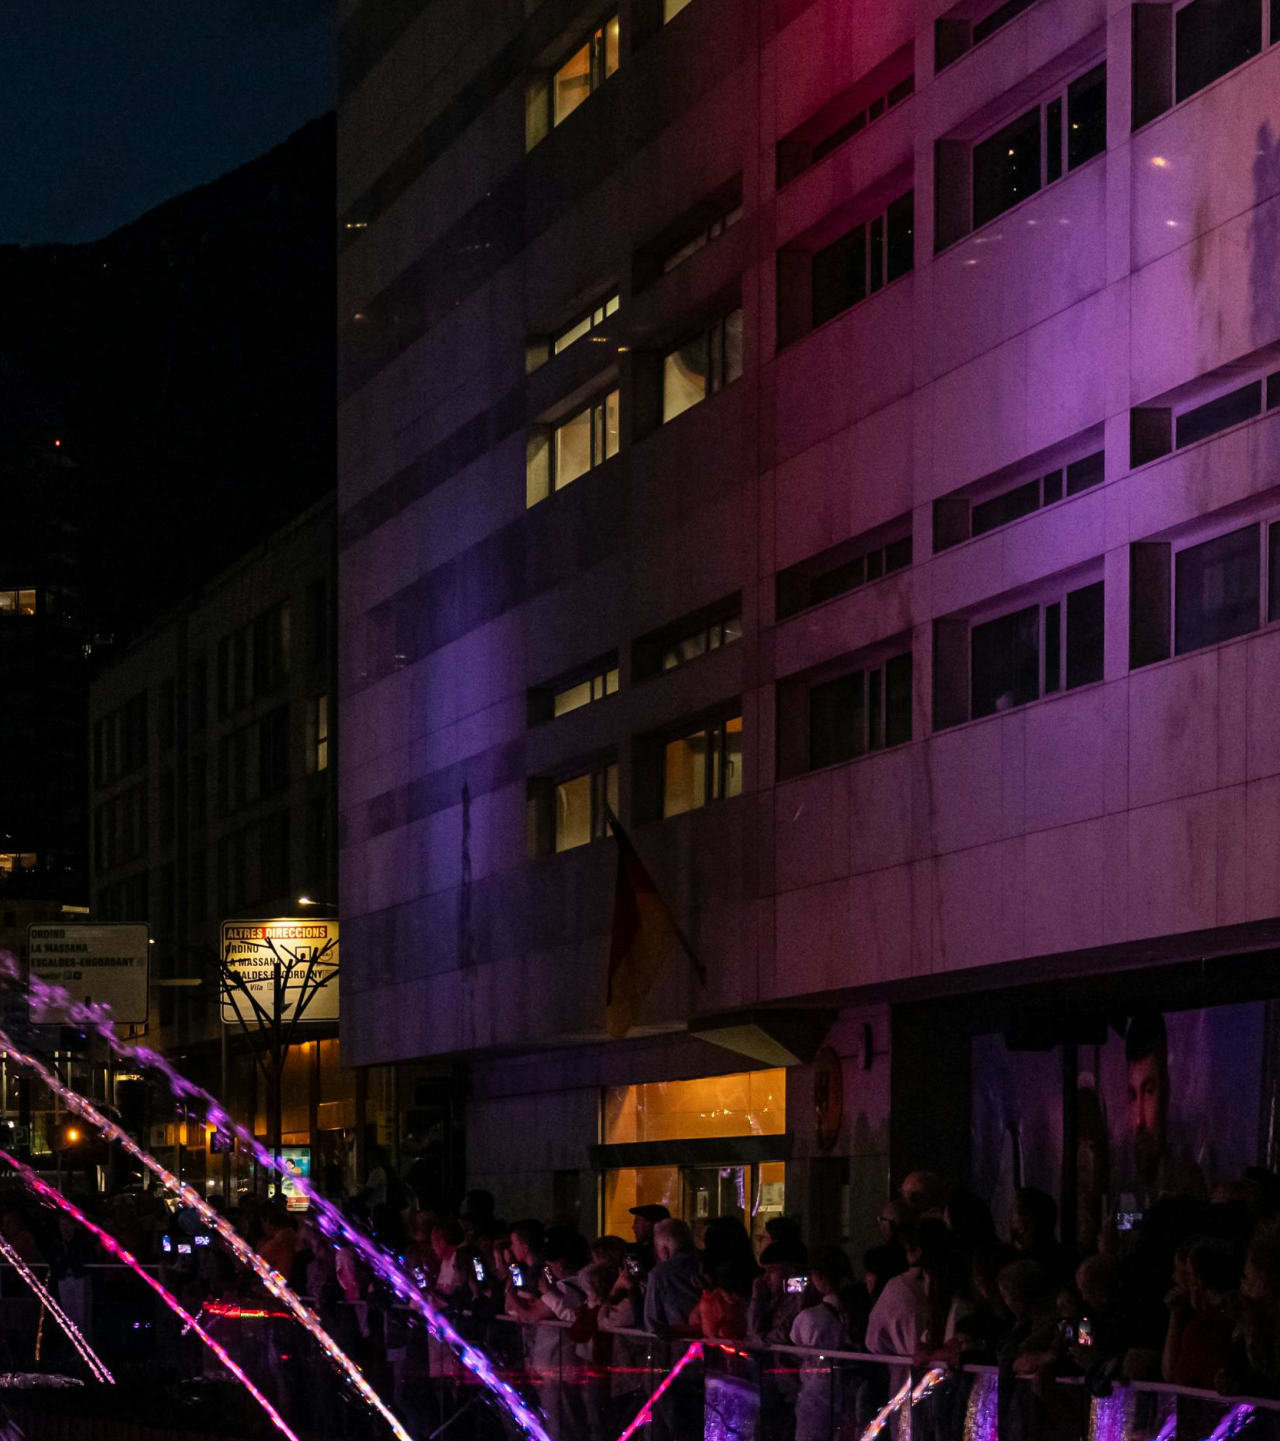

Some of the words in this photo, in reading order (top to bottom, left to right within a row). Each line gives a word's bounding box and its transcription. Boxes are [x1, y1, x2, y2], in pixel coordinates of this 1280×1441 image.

[31, 929, 66, 939] ORDINO
[227, 928, 263, 939] ALTRES
[265, 927, 327, 938] DIRECCIONS
[31, 943, 42, 953] LA
[45, 943, 89, 953] MASSANA
